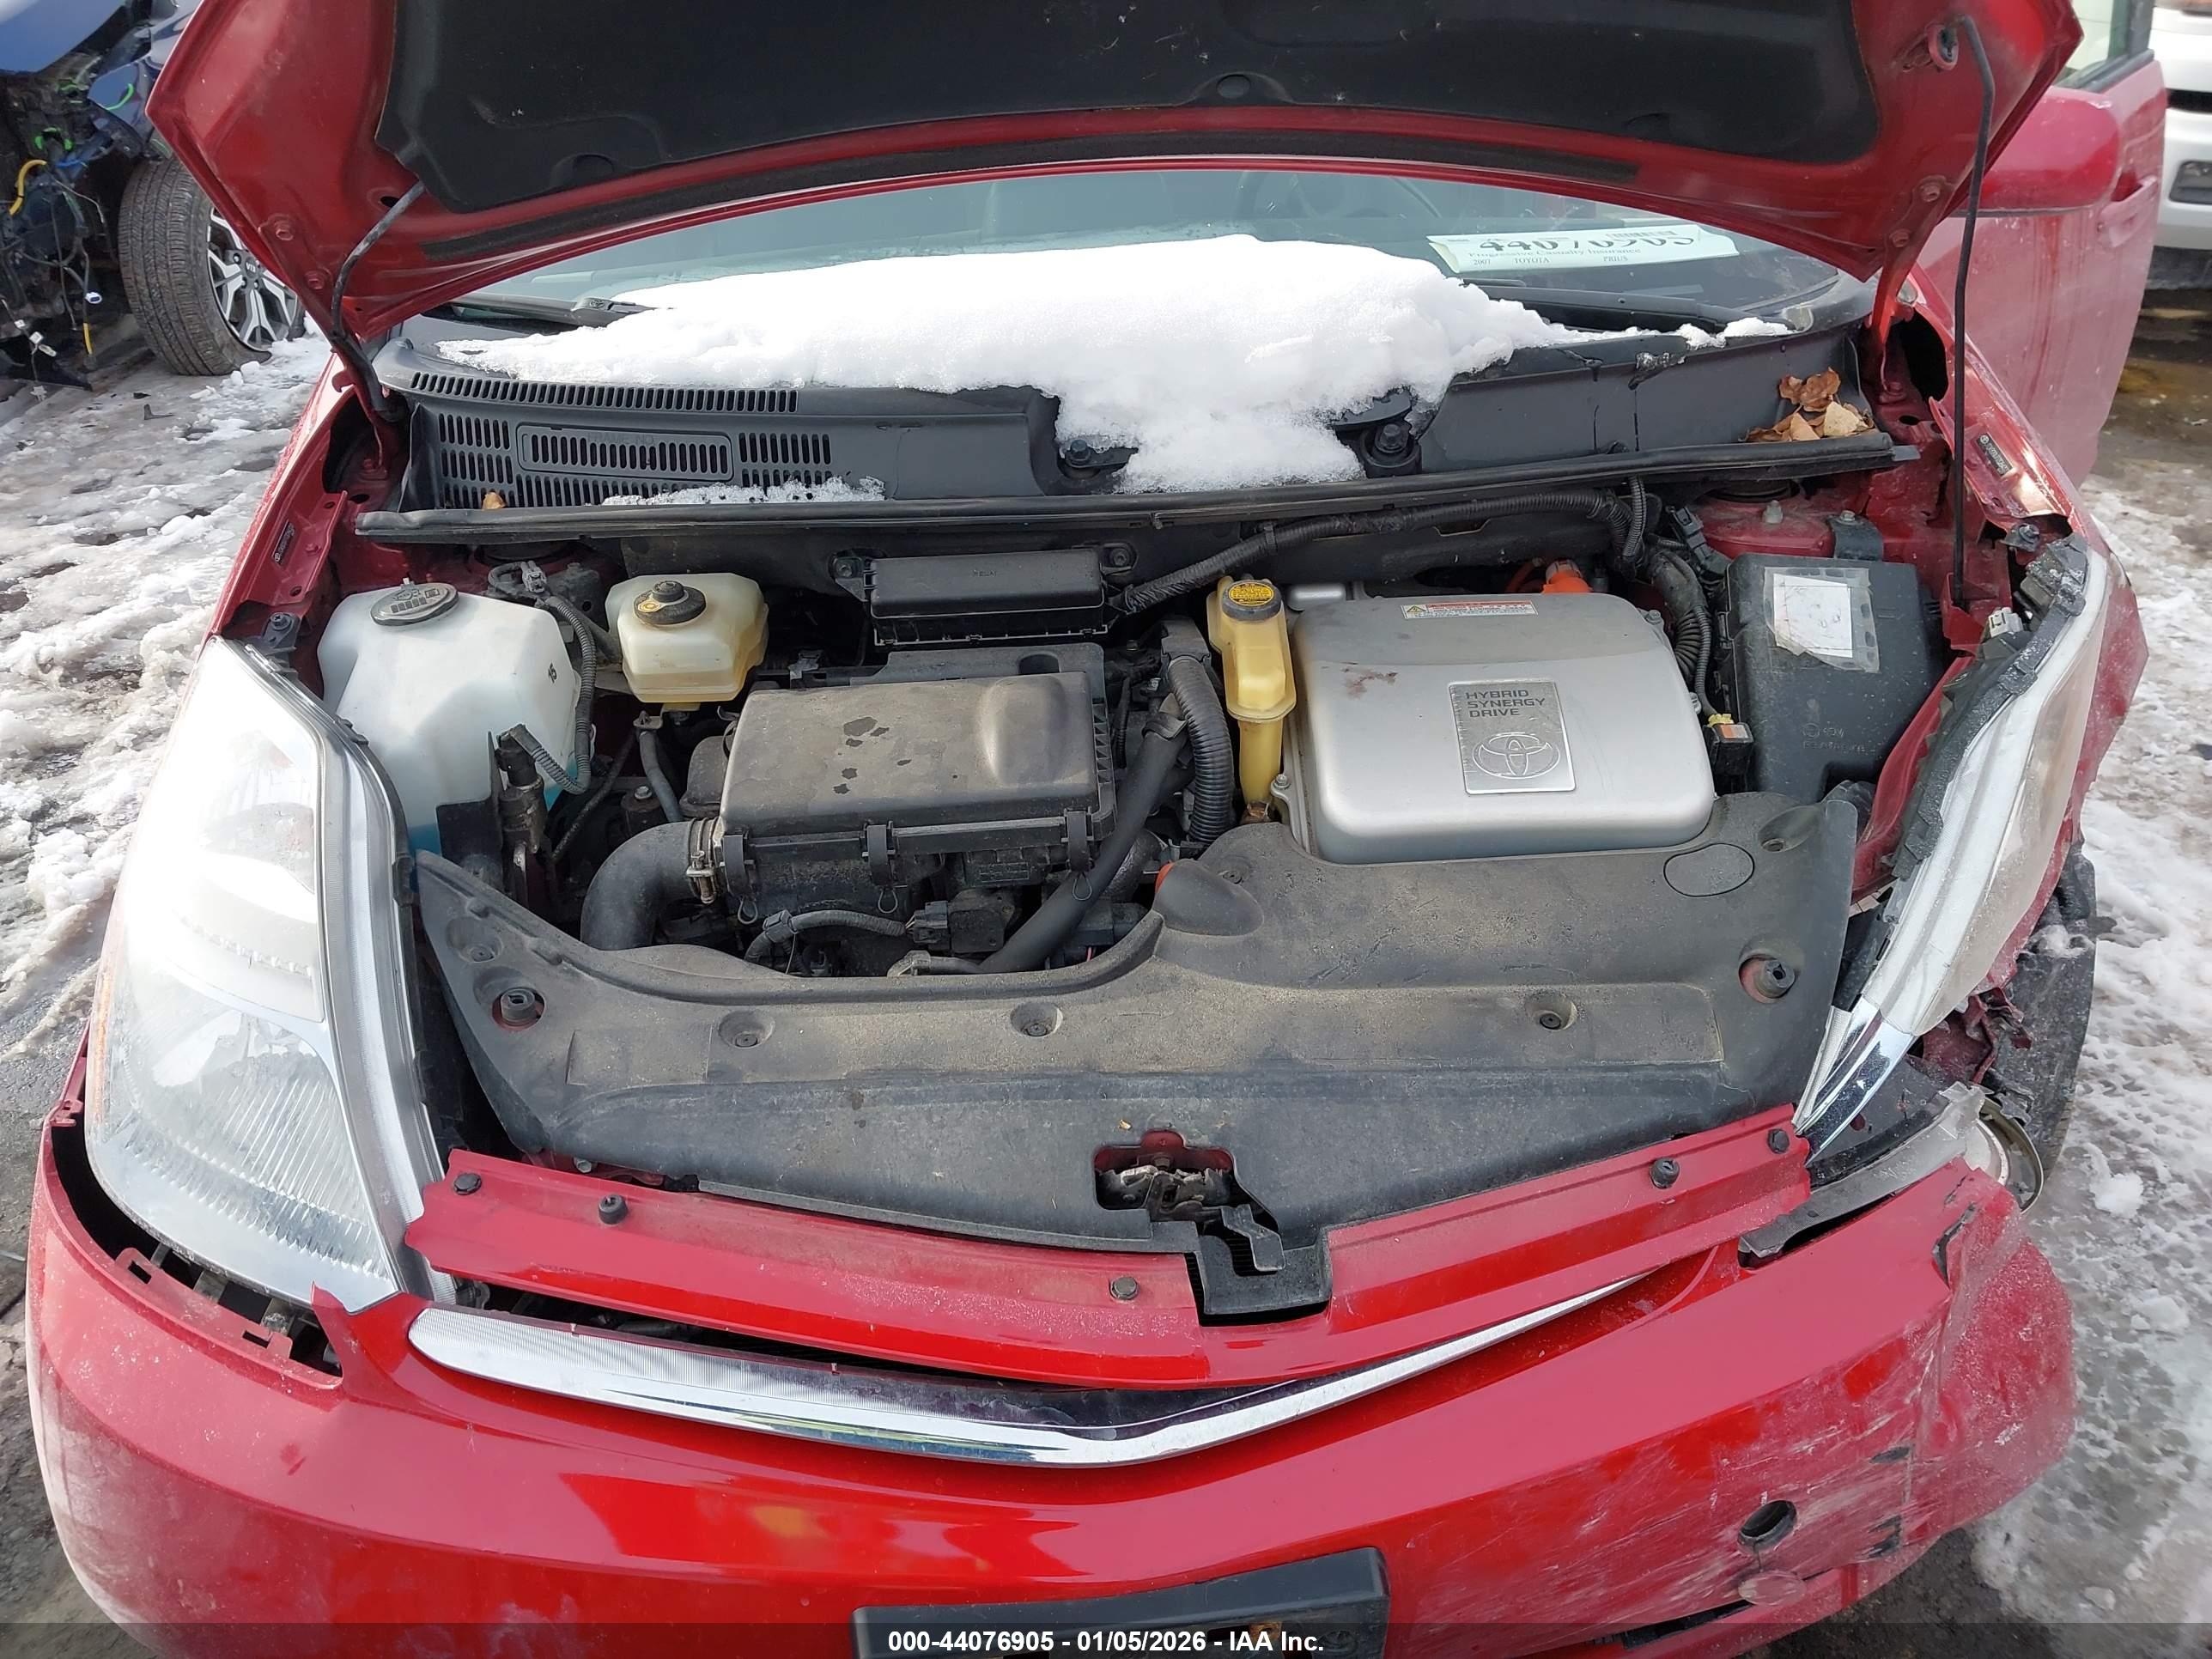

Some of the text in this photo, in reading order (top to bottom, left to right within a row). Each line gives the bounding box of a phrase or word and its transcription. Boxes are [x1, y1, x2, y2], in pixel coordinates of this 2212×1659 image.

[1466, 690, 1528, 699] HYBRID
[1468, 698, 1545, 708] SYNERGY
[1469, 708, 1520, 718] DRIVE
